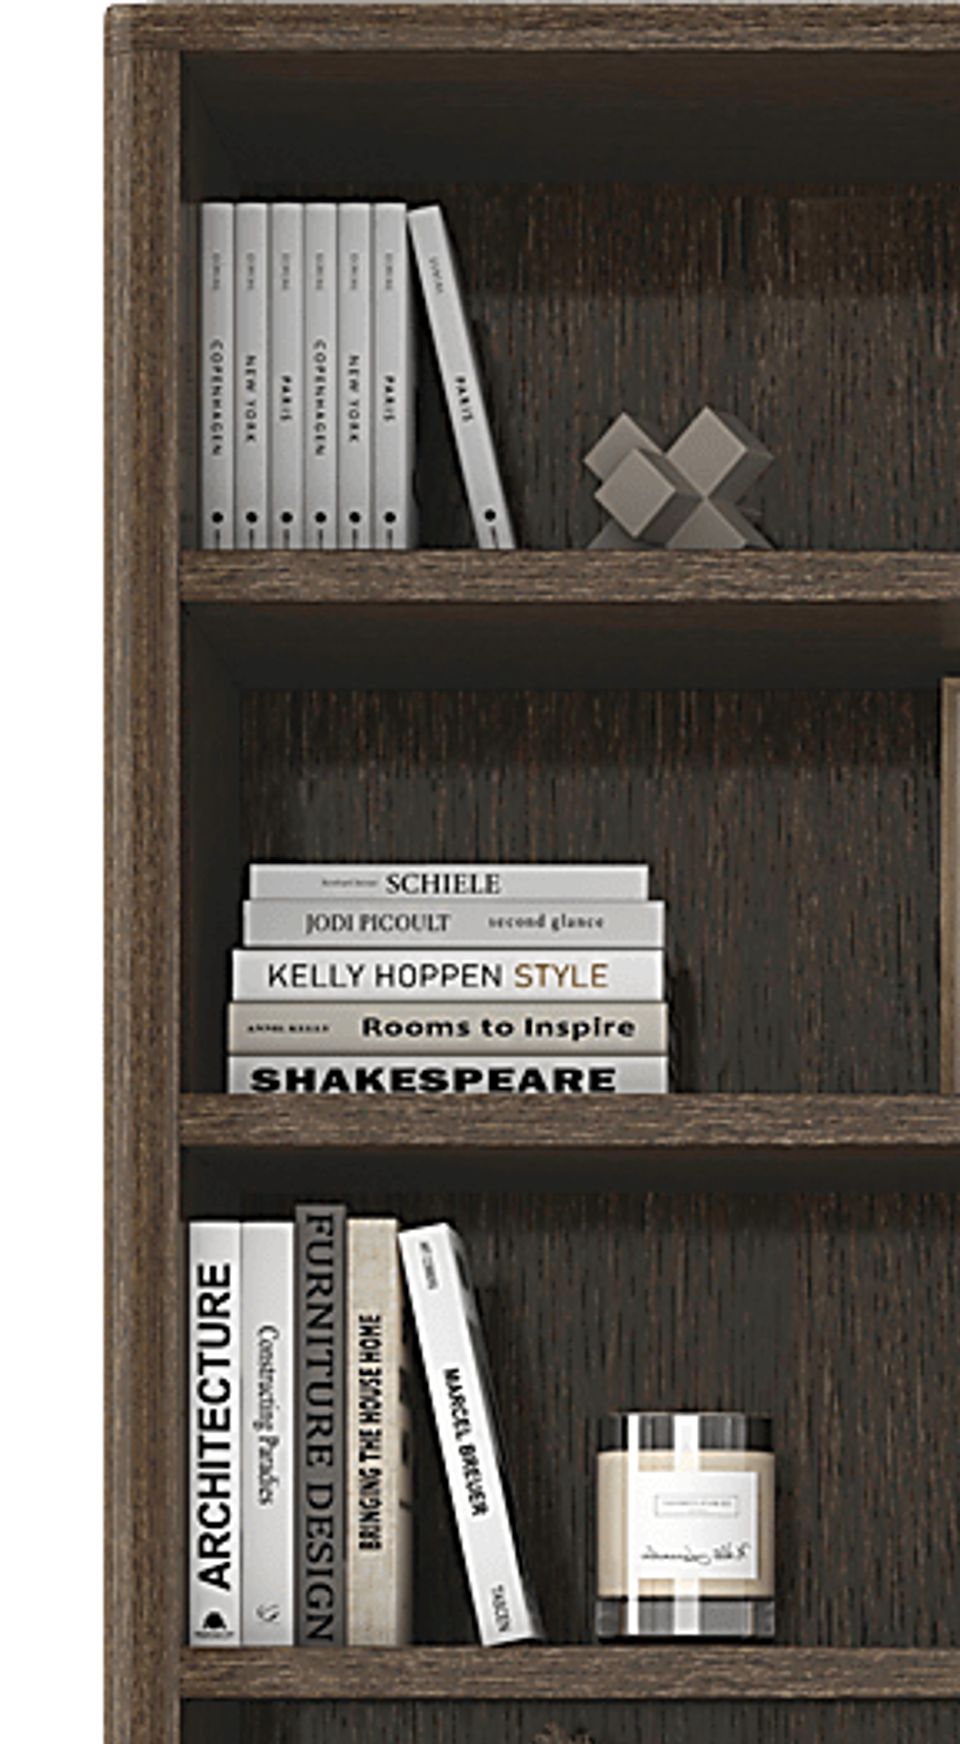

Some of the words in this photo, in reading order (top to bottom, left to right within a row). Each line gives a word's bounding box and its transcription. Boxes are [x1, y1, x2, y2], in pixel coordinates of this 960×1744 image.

[245, 355, 257, 393] NEW
[348, 355, 360, 393] NEW
[209, 338, 224, 457] COPENHAGEN
[280, 375, 292, 421] PARIS
[313, 338, 327, 457] COPENHAGEN
[384, 375, 396, 421] PARIS
[455, 376, 474, 423] PARIS
[245, 400, 257, 443] YORK
[348, 400, 360, 443] YORK
[385, 873, 501, 894] SCHIELE
[305, 914, 353, 934] JODI
[359, 914, 450, 932] PICOULT
[488, 914, 546, 928] second
[551, 914, 604, 932] glance
[268, 963, 365, 988] KELLY
[375, 963, 502, 988] HOPPEN
[514, 963, 609, 988] STYLE
[362, 1017, 470, 1037] Rooms
[481, 1018, 515, 1037] to
[525, 1016, 636, 1041] Inspire
[251, 1067, 616, 1094] SHAKESPEARE
[306, 1214, 334, 1467] FURNITURE
[358, 1314, 383, 1363] HOME
[253, 1325, 280, 1431] Constructing
[358, 1368, 383, 1424] HOUSE
[443, 1367, 472, 1441] MARCEL
[196, 1263, 231, 1592] ARCHITECTURE
[358, 1429, 383, 1462] THE
[457, 1443, 489, 1518] BREUER
[358, 1468, 383, 1550] BRINGING
[306, 1484, 334, 1641] DESIGN
